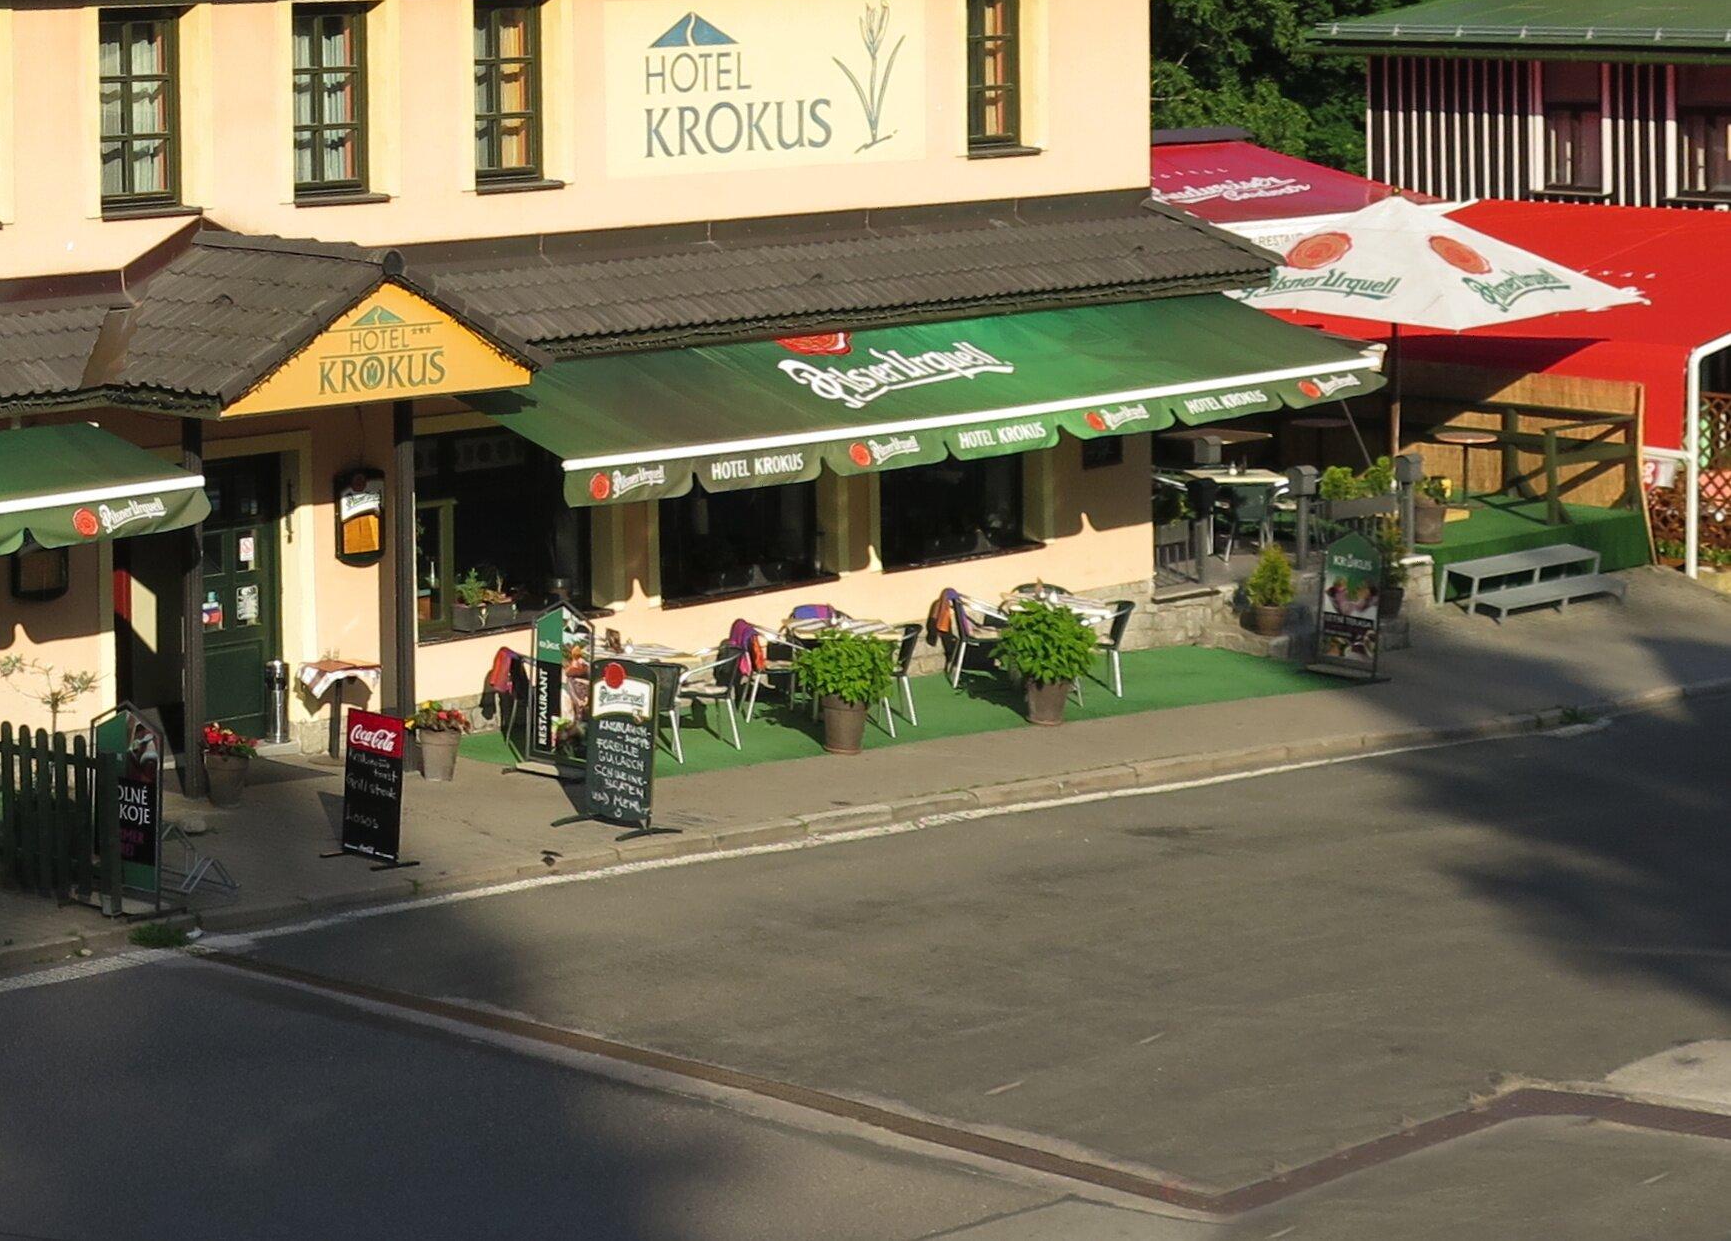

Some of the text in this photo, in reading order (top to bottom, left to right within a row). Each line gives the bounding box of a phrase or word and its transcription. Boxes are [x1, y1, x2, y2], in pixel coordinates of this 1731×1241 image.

[645, 52, 752, 94] HOTEL
[644, 98, 832, 158] KROKUS
[1322, 268, 1402, 297] Urquell
[350, 329, 410, 353] HOTEL
[318, 350, 446, 395] KROKUS
[778, 341, 1003, 409] Pilsner Urquell
[1184, 389, 1269, 415] HOTEL KROKUS
[958, 421, 1047, 449] HOTEL KROKUS
[712, 452, 805, 481] HOTEL KROKUS
[98, 497, 166, 534] Pilsner Urquell
[538, 667, 549, 746] RESTAURANT
[118, 785, 149, 806] OLNÉ
[120, 805, 151, 826] KOJE
